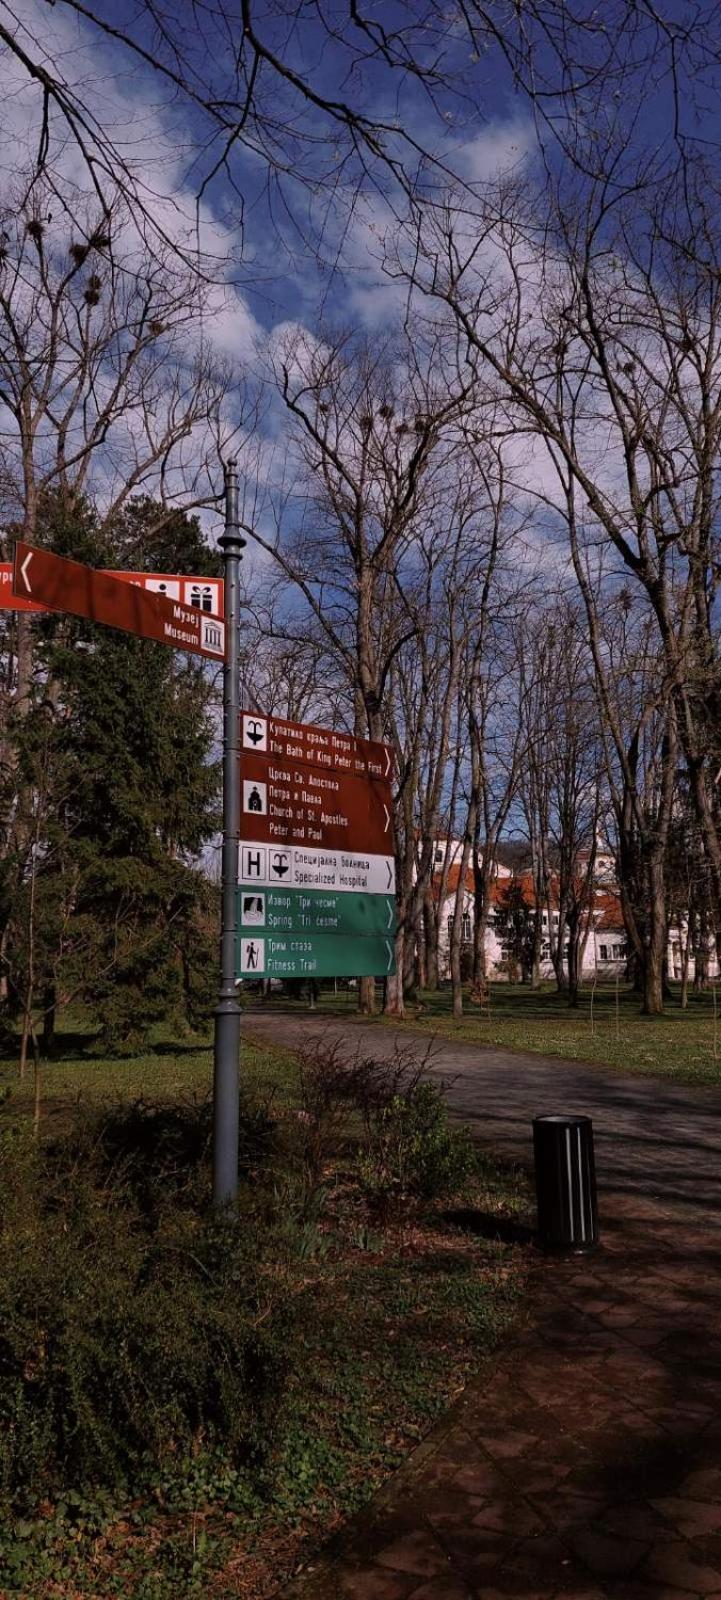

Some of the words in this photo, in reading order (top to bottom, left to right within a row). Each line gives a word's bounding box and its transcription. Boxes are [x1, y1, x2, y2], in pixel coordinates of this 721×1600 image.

[173, 605, 199, 628] Музеј
[164, 622, 199, 645] Museum
[332, 736, 350, 751] Петра
[270, 741, 283, 754] The
[287, 745, 303, 756] Bath
[307, 750, 314, 759] of
[317, 751, 332, 766] King
[335, 755, 351, 767] Peter
[355, 760, 364, 770] the
[368, 762, 382, 774] First
[269, 767, 291, 781] Црква
[269, 786, 290, 800] Петра
[270, 805, 293, 817] Church
[296, 808, 304, 819] of
[321, 813, 348, 826] Apostles
[270, 824, 288, 835] Peter
[292, 827, 305, 838] and
[308, 827, 322, 840] Paul
[295, 872, 335, 884] Specialized
[340, 875, 367, 887] Hospital
[268, 914, 292, 928] Spring
[290, 941, 312, 951] стаза
[267, 959, 295, 970] Fitness
[300, 959, 316, 970] Trail
